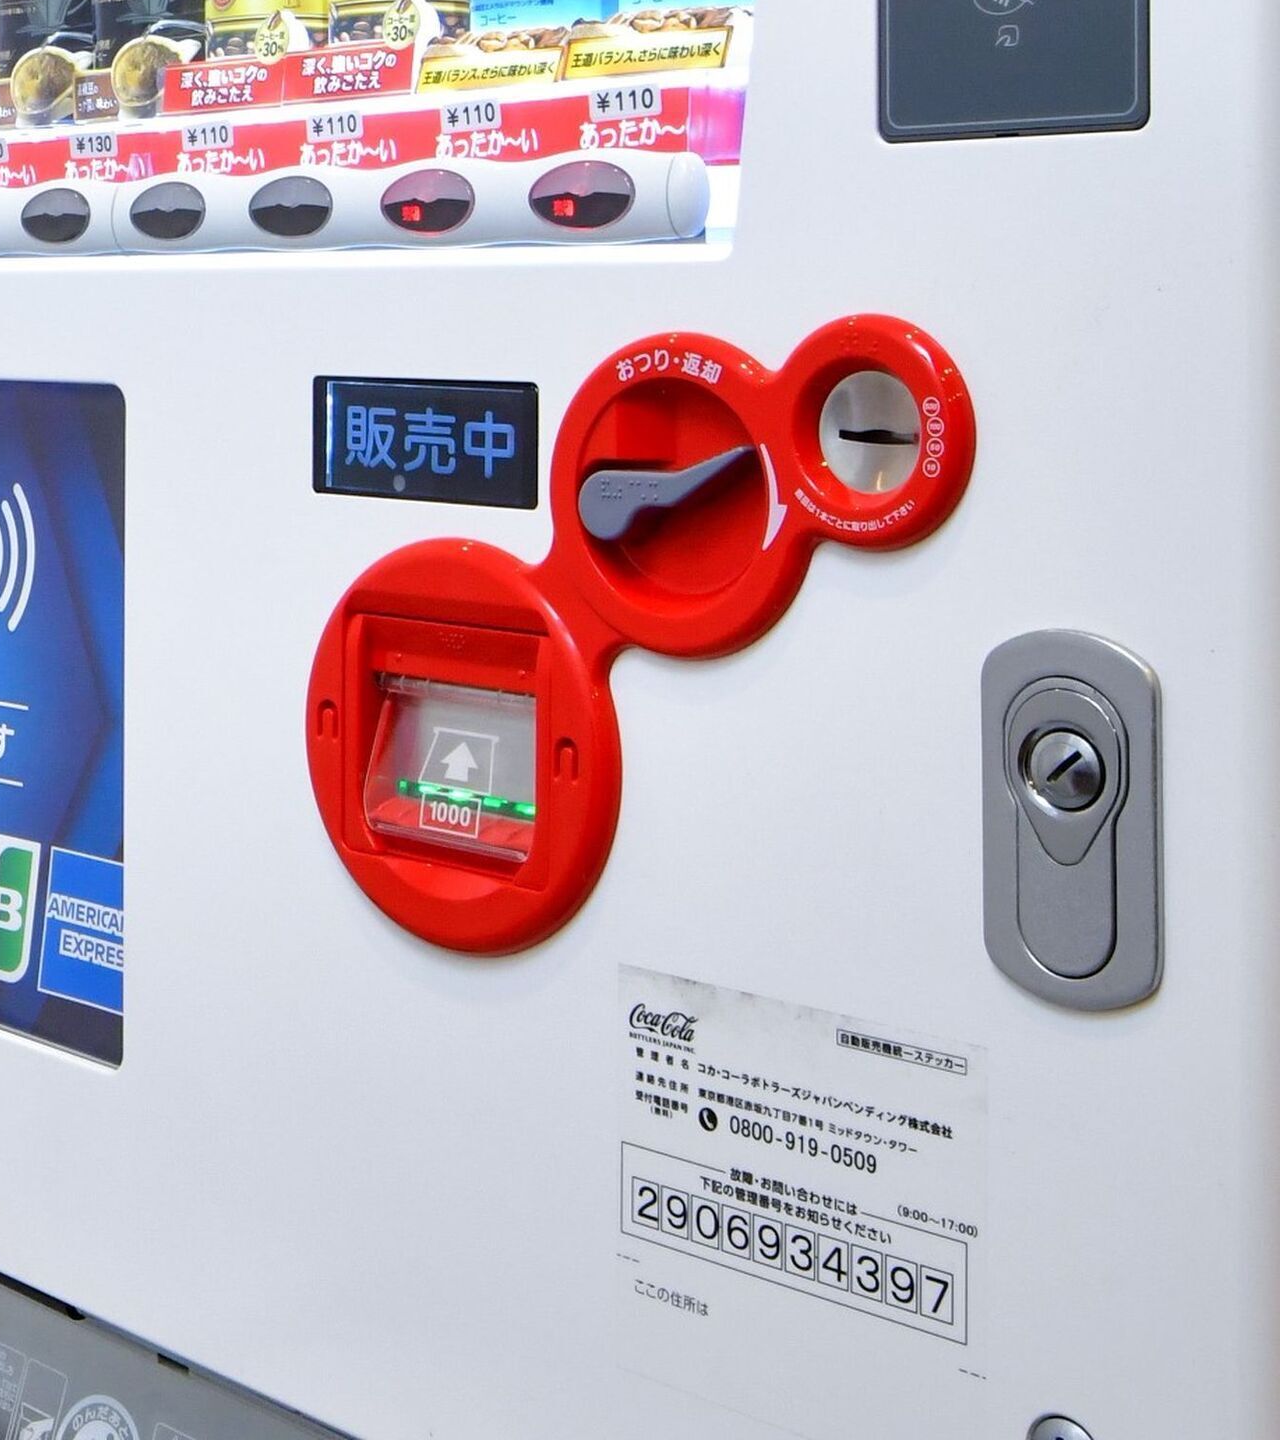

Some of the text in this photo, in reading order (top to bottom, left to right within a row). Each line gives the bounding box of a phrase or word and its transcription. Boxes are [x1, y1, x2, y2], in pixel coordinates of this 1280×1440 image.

[480, 13, 517, 27] コーヒー
[571, 42, 721, 69] 王道バランス、さらに味わい深く
[422, 60, 555, 85] 王道バランス、さらに味わい深く
[447, 103, 495, 127] ¥110
[597, 88, 653, 113] ¥110
[188, 125, 228, 145] ¥110
[312, 114, 357, 136] ¥110
[300, 139, 397, 167] あったか～い
[435, 128, 539, 159] あったか～い
[177, 148, 265, 175] あったか～い
[615, 348, 724, 385] おつり・返却
[344, 404, 517, 480] 販売中
[428, 799, 472, 829] 1000
[629, 1003, 698, 1042] Coca-Cola
[629, 1031, 661, 1045] BOTTLERS
[663, 1040, 682, 1050] JAPAN
[840, 1033, 964, 1070] 自動販売機統一ステッカー
[636, 1047, 954, 1140] 管理者名 コカ・コーラボトラーズジャパンベンディング株式会社
[635, 1071, 918, 1153] 連絡先住所 東京都港区赤坂九丁目7番1号 ミッドタウン・タワー
[635, 1090, 877, 1174] 受付電話番号 0800-919-0509
[730, 1168, 858, 1216] 故障・お問い合わせには
[699, 1176, 892, 1245] 下記の管理番号をお知らせください
[637, 1186, 949, 1315] 2906934397
[633, 1279, 709, 1317] ここの住所は
